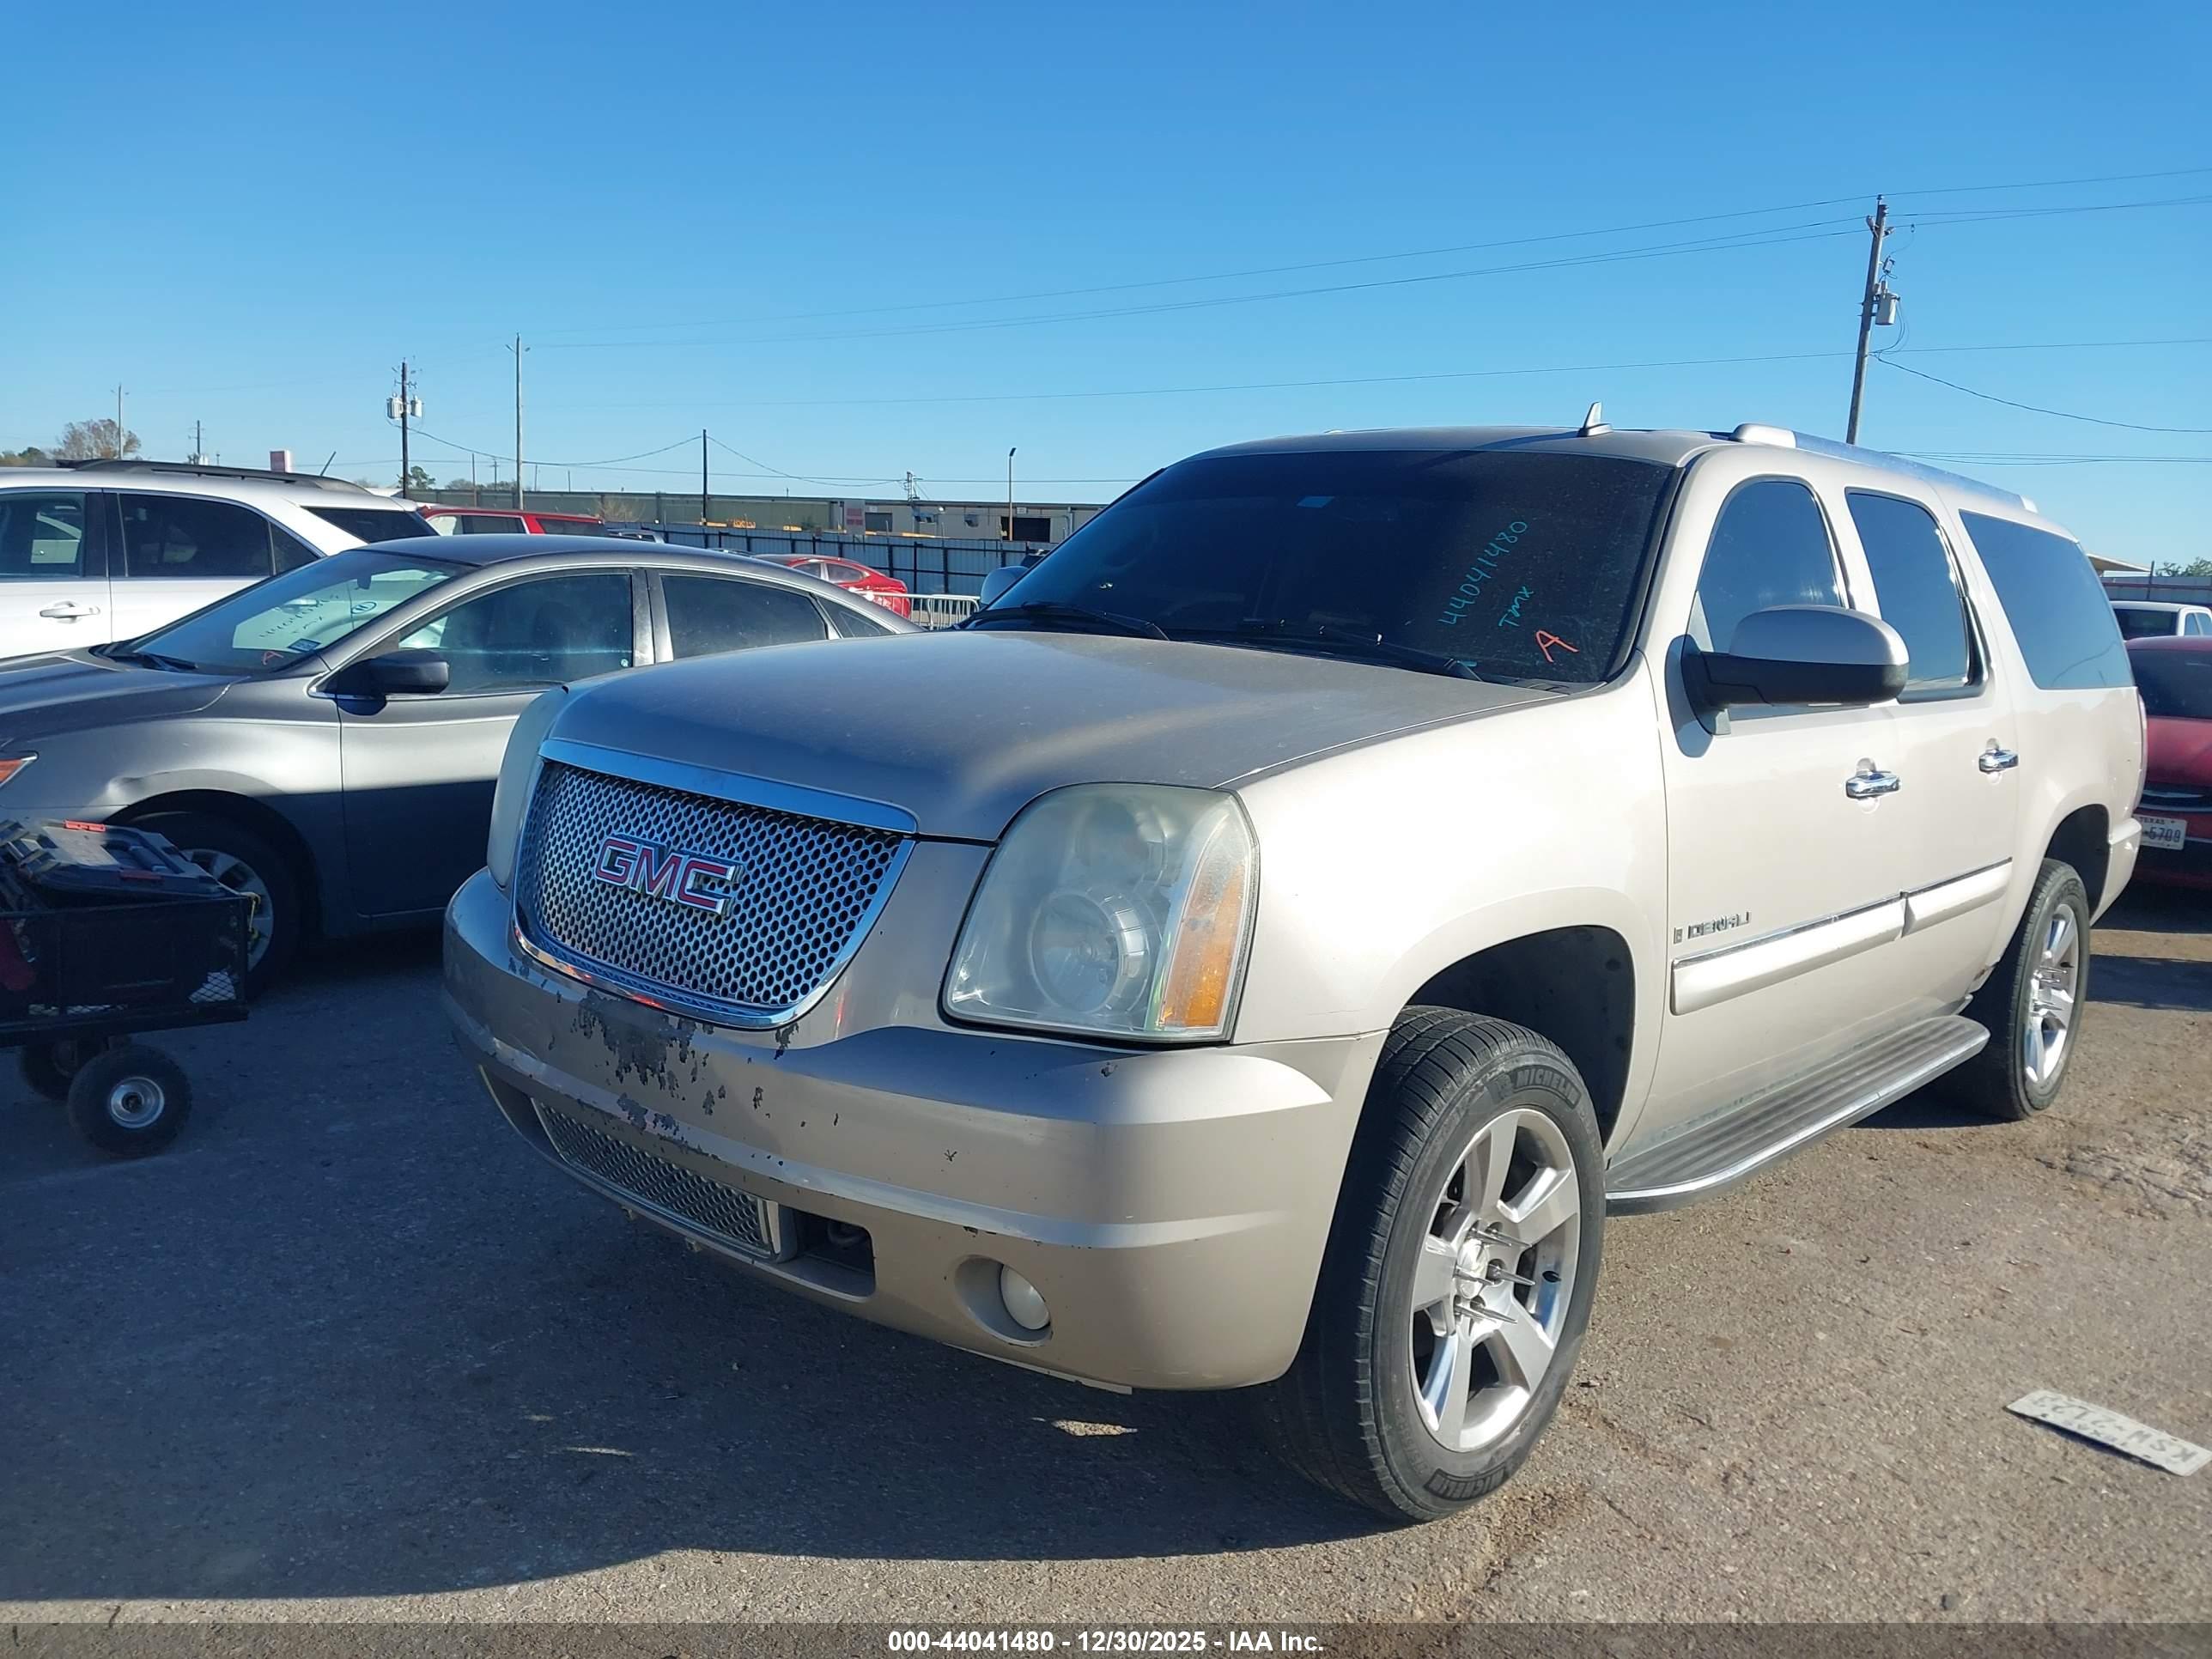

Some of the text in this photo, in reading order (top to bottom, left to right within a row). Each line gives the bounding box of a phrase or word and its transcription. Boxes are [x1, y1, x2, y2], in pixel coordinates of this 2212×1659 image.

[1437, 521, 1528, 625] 44041480
[261, 650, 285, 665] A
[1535, 629, 1580, 663] A
[594, 836, 738, 916] GMC
[1687, 911, 1750, 939] DENALI
[1515, 1067, 1579, 1105] MICHELIN
